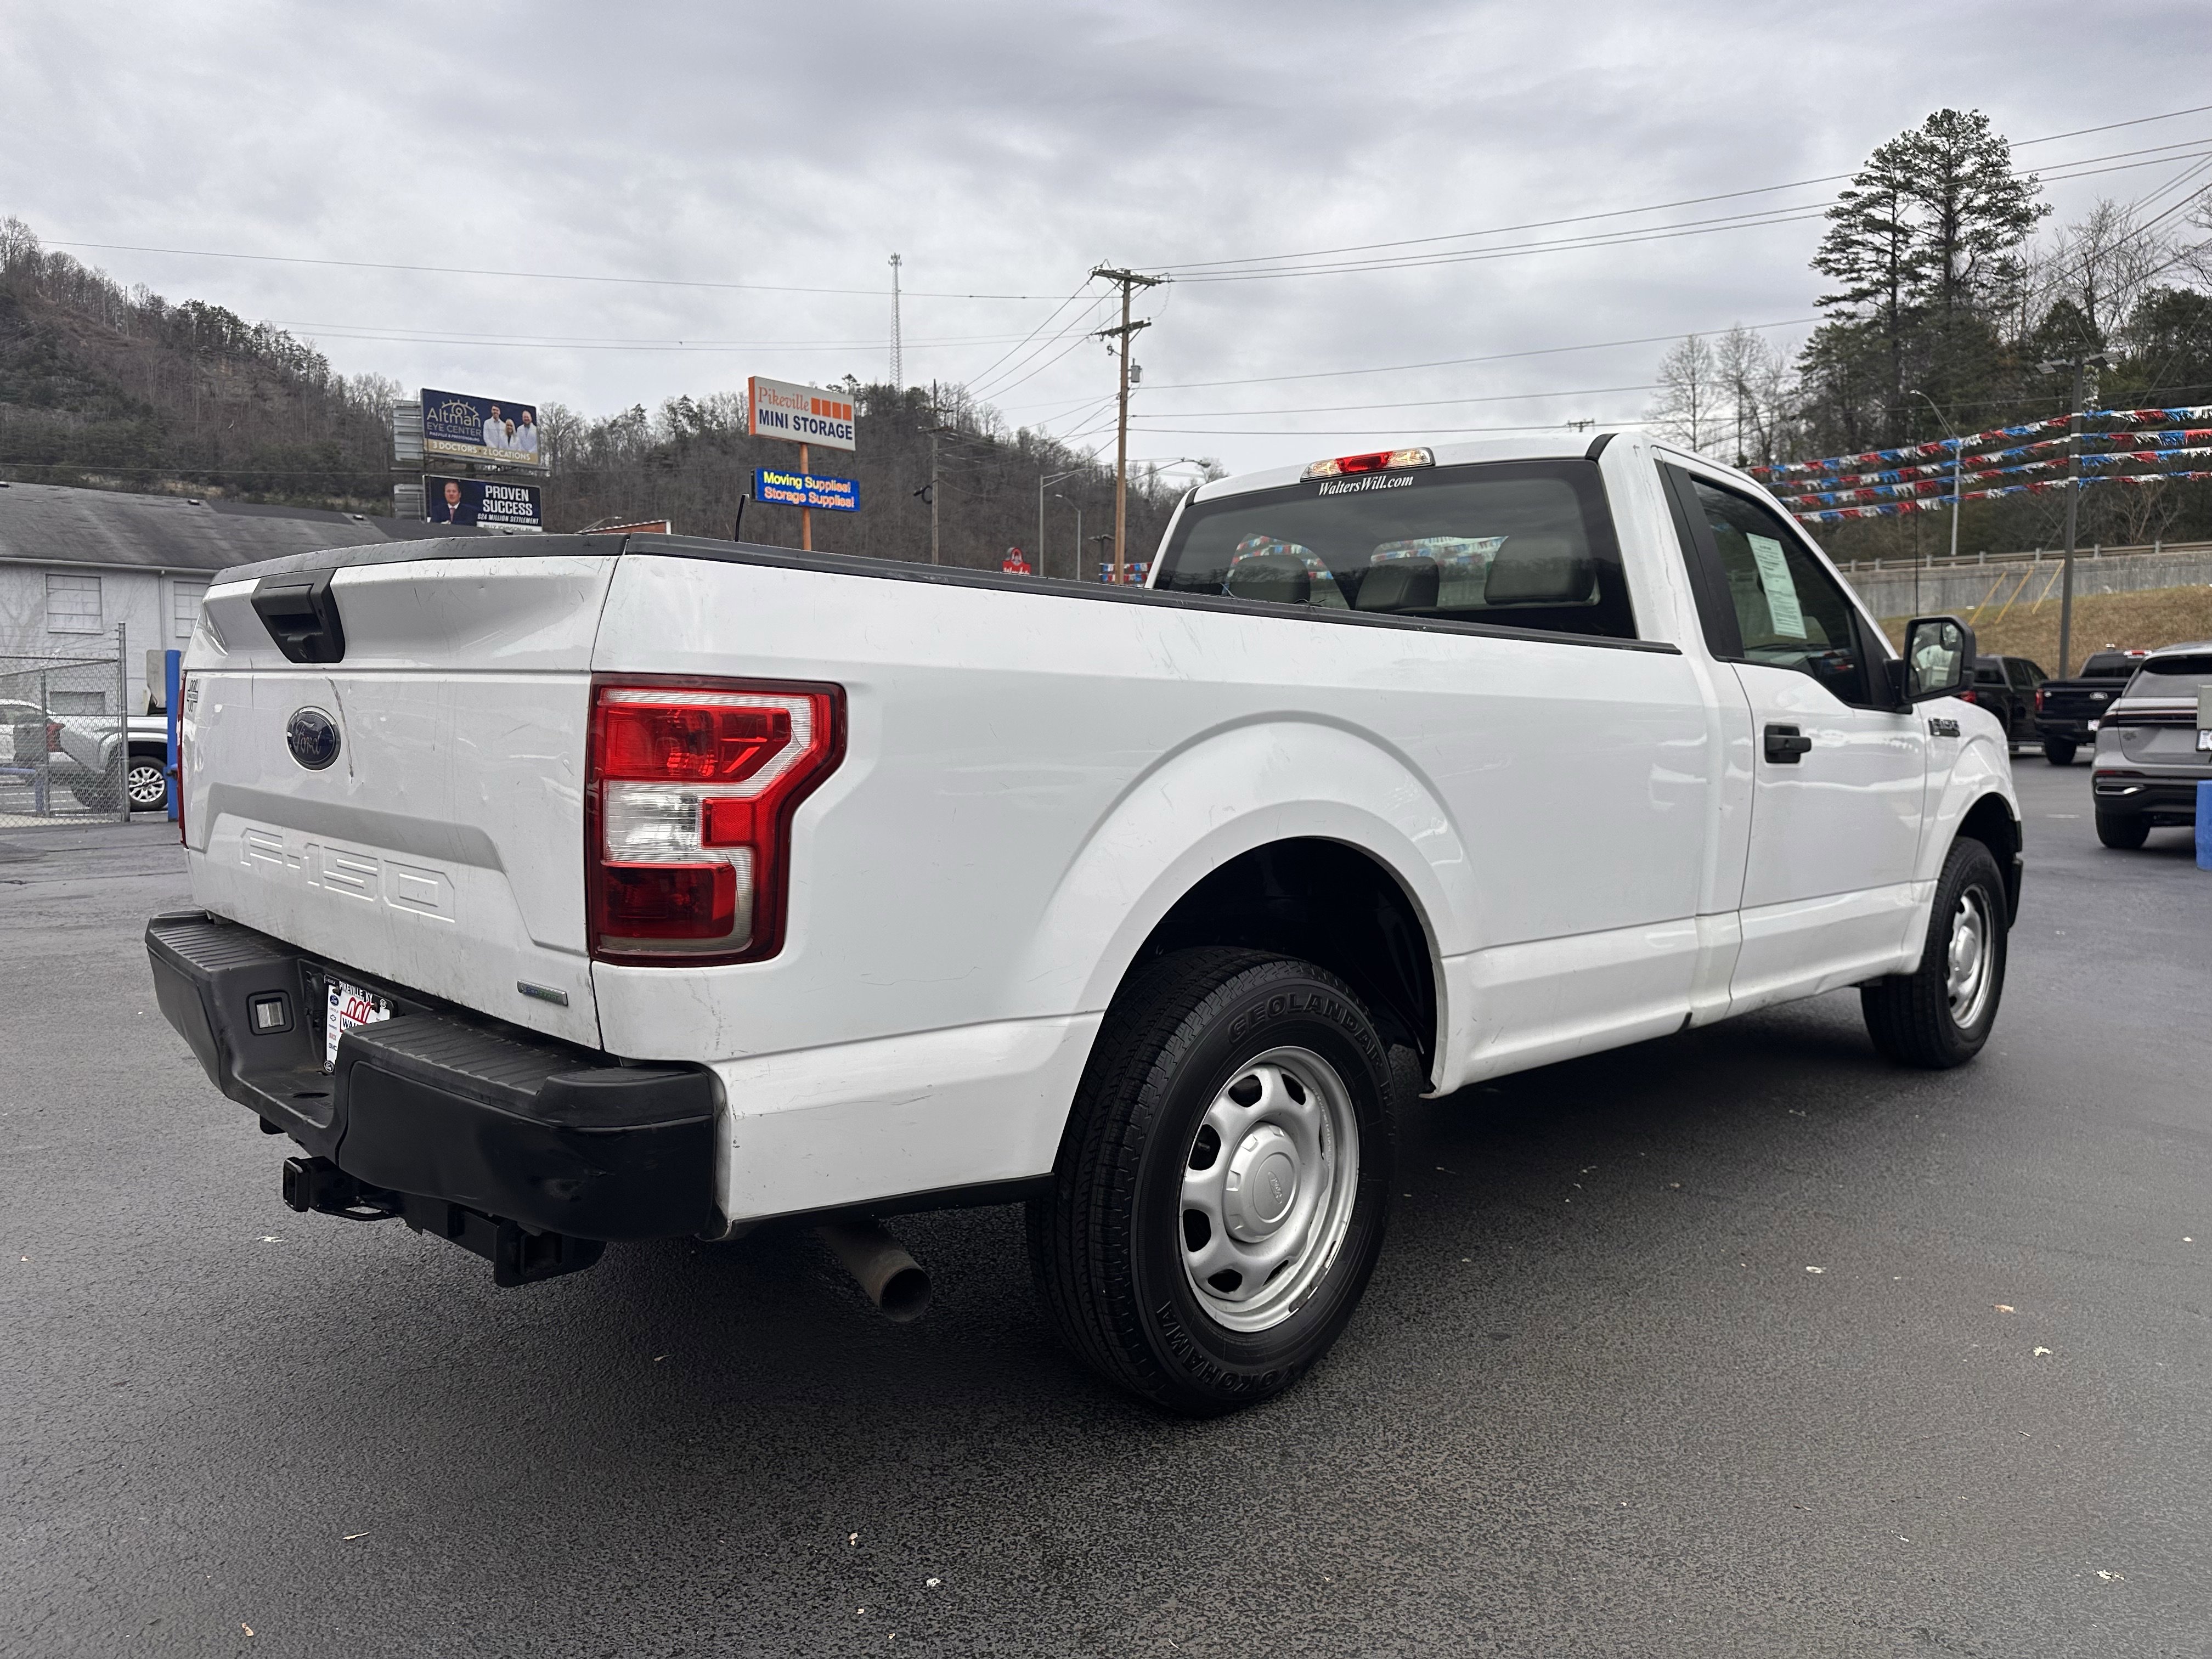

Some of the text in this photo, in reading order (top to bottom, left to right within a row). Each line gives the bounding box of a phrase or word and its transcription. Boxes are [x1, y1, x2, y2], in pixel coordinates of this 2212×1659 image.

[758, 386, 809, 411] Pikeville
[427, 407, 481, 428] Altman
[759, 409, 853, 440] MINI STORAGE
[427, 422, 482, 436] EYE CENTER
[439, 442, 477, 454] DOCTORS
[489, 449, 531, 461] LOCATIONS
[764, 471, 851, 493] Moving Supplies!
[1318, 475, 1414, 496] WaltersWill.com
[485, 485, 529, 501] PROVEN
[764, 487, 854, 508] Storage Supplies!
[483, 499, 533, 516] SUCCESS
[292, 719, 323, 754] Ford
[240, 827, 455, 922] F-150
[365, 992, 373, 1003] KY
[1227, 992, 1384, 1067] GEOLANDAR
[1156, 1300, 1295, 1392] YOKOHAMA
